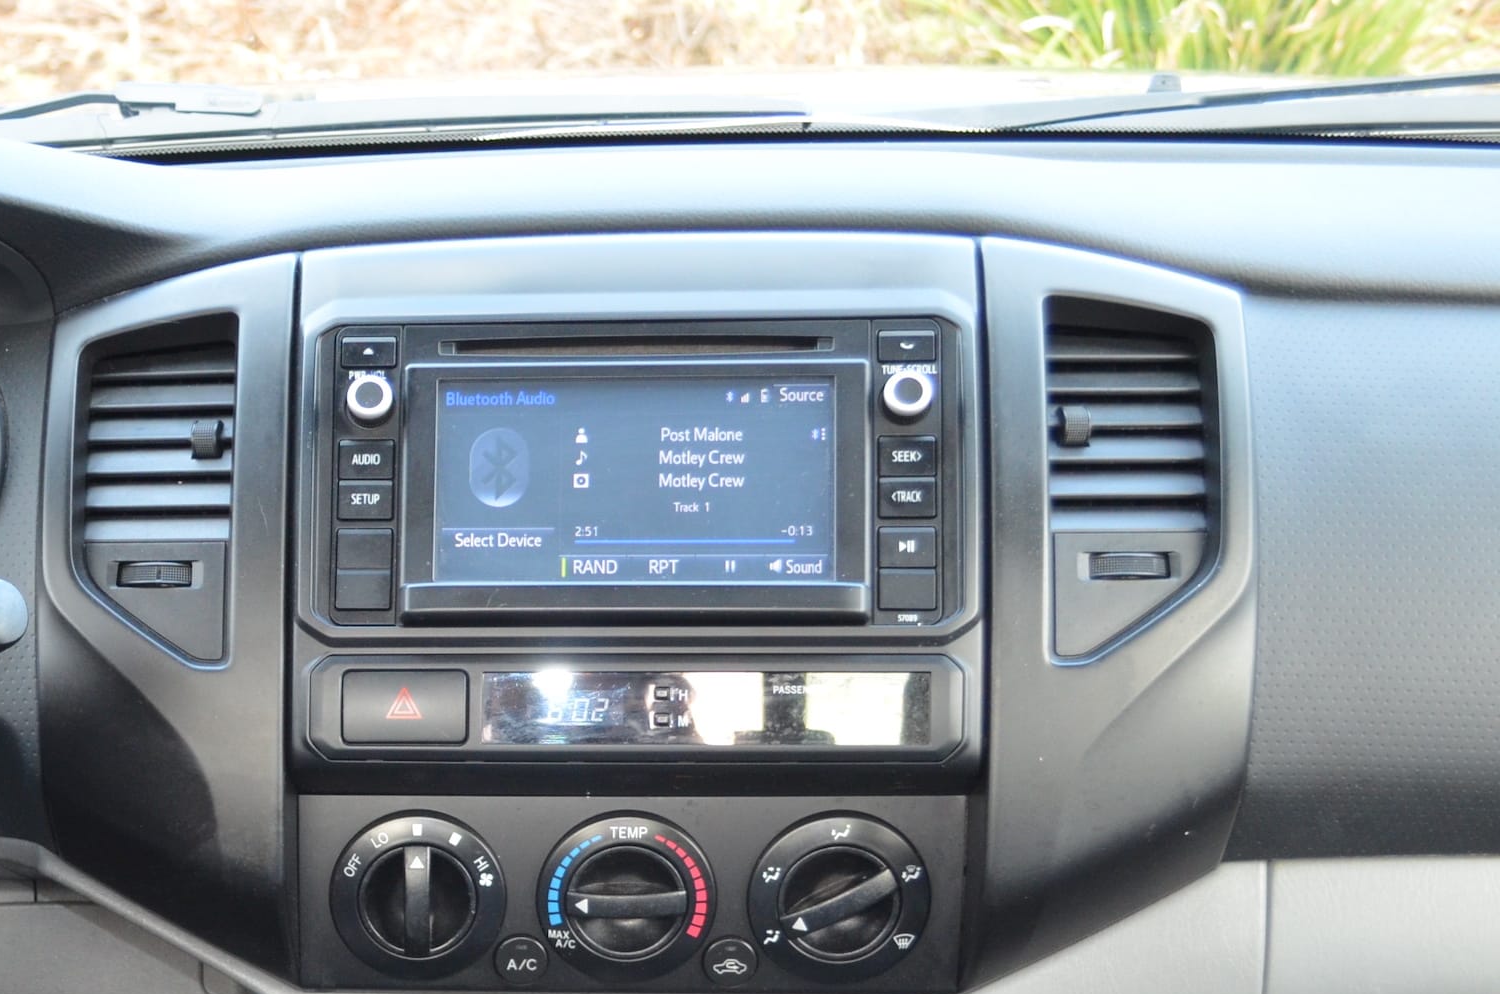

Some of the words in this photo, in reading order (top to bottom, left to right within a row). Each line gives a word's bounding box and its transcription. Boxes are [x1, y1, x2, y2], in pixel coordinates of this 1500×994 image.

[445, 391, 514, 407] Bluetooth
[516, 391, 556, 407] Audio
[779, 387, 825, 403] Source
[660, 427, 690, 442] Post
[693, 427, 744, 442] Malone
[351, 453, 381, 466] AUDIO
[658, 450, 706, 468] Motley
[708, 450, 745, 465] Crew
[658, 473, 706, 491] Motley
[708, 473, 745, 488] Crew
[350, 492, 381, 505] SETUP
[673, 501, 700, 513] Track
[704, 501, 711, 513] 1
[574, 525, 599, 537] 2:51
[781, 525, 814, 537] -0:13
[454, 532, 494, 548] Select
[496, 532, 543, 548] Device
[572, 559, 619, 575] RAND
[648, 559, 680, 575] RPT
[785, 559, 823, 575] Sound
[678, 689, 689, 700] H
[677, 715, 690, 728] M
[370, 832, 389, 849] LO
[609, 826, 649, 840] TEMP
[343, 853, 363, 878] OFF
[473, 855, 491, 872] HI
[547, 929, 570, 940] MAX
[555, 938, 576, 950] A/C
[506, 958, 538, 971] A/C
